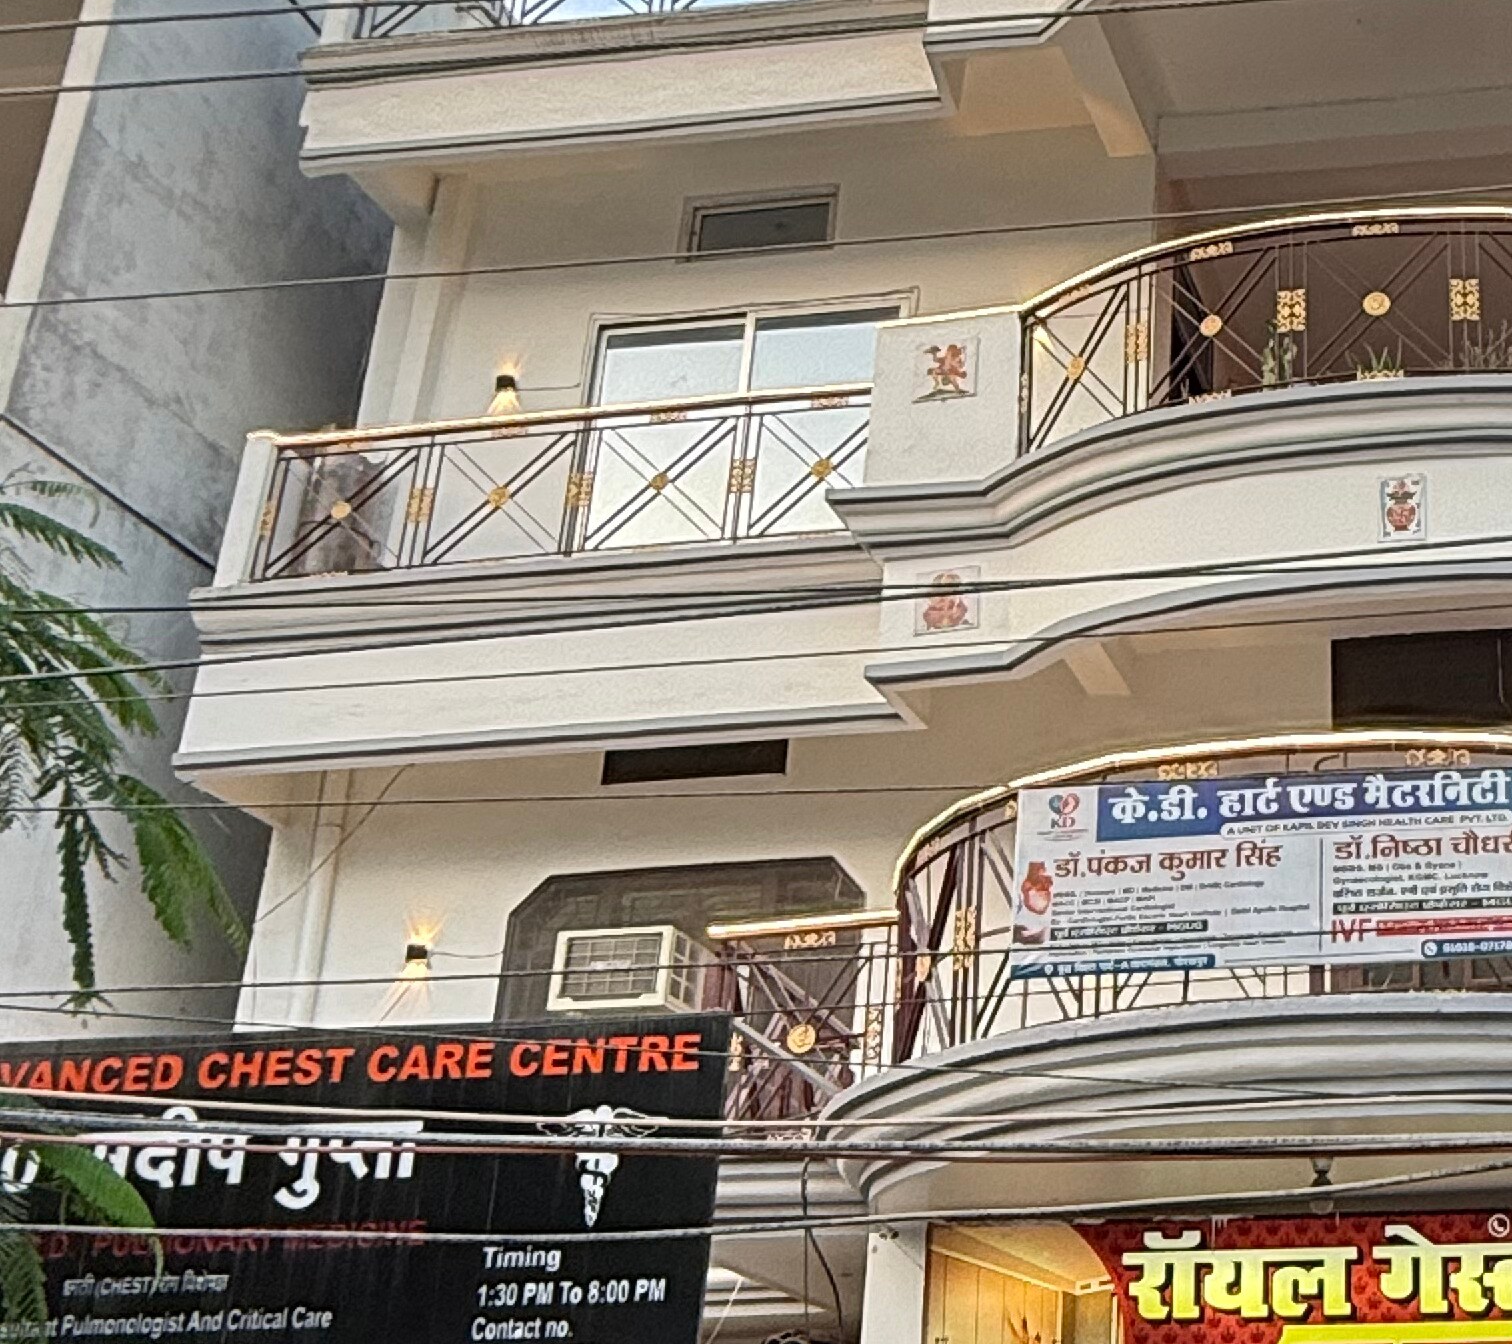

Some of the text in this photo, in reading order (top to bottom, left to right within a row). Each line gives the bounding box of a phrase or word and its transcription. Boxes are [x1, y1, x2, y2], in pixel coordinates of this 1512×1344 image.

[1108, 784, 1208, 824] के.डी.
[1217, 777, 1283, 818] हार्ट
[1287, 782, 1357, 813] एण्ड
[1363, 769, 1512, 809] मैटरनिटी
[1424, 815, 1454, 826] CARE
[1157, 849, 1229, 881] कुमार
[1236, 838, 1284, 868] सिंह
[1331, 918, 1372, 943] IVF
[198, 1047, 355, 1089] CHEST
[366, 1041, 495, 1082] CARE
[509, 1032, 702, 1077] CENTRE
[482, 1245, 562, 1272] Timing
[1122, 1229, 1359, 1321] रॉयल
[477, 1277, 666, 1307] 1:30 PM To 8:00 PM
[61, 1313, 186, 1340] Pulmonologist
[187, 1309, 224, 1332] And
[227, 1306, 290, 1331] Critical
[292, 1305, 333, 1330] Care
[471, 1316, 574, 1341] Contact no.
